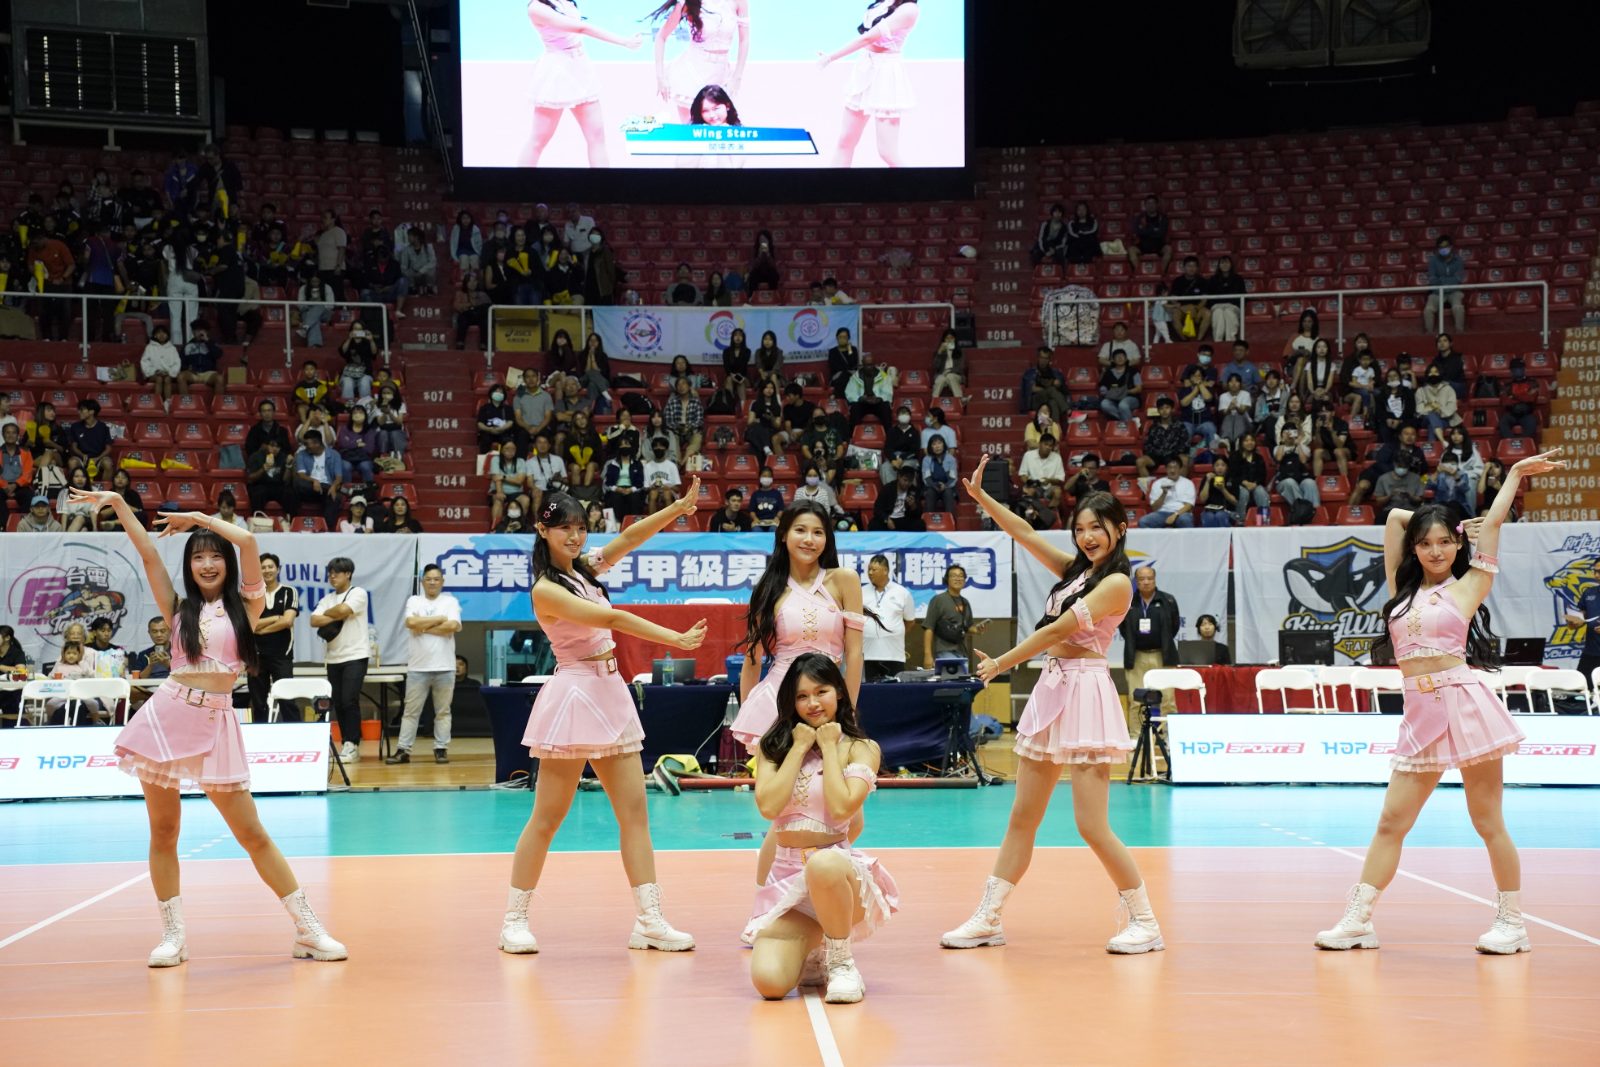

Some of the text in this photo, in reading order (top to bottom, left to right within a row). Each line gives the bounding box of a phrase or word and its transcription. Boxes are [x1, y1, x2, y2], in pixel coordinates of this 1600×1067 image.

[692, 128, 758, 139] Wing Stars
[1180, 742, 1303, 754] HOP SPORTS
[1323, 742, 1368, 754] HOP
[1518, 743, 1595, 755] SPORTS
[37, 755, 87, 769] HOP
